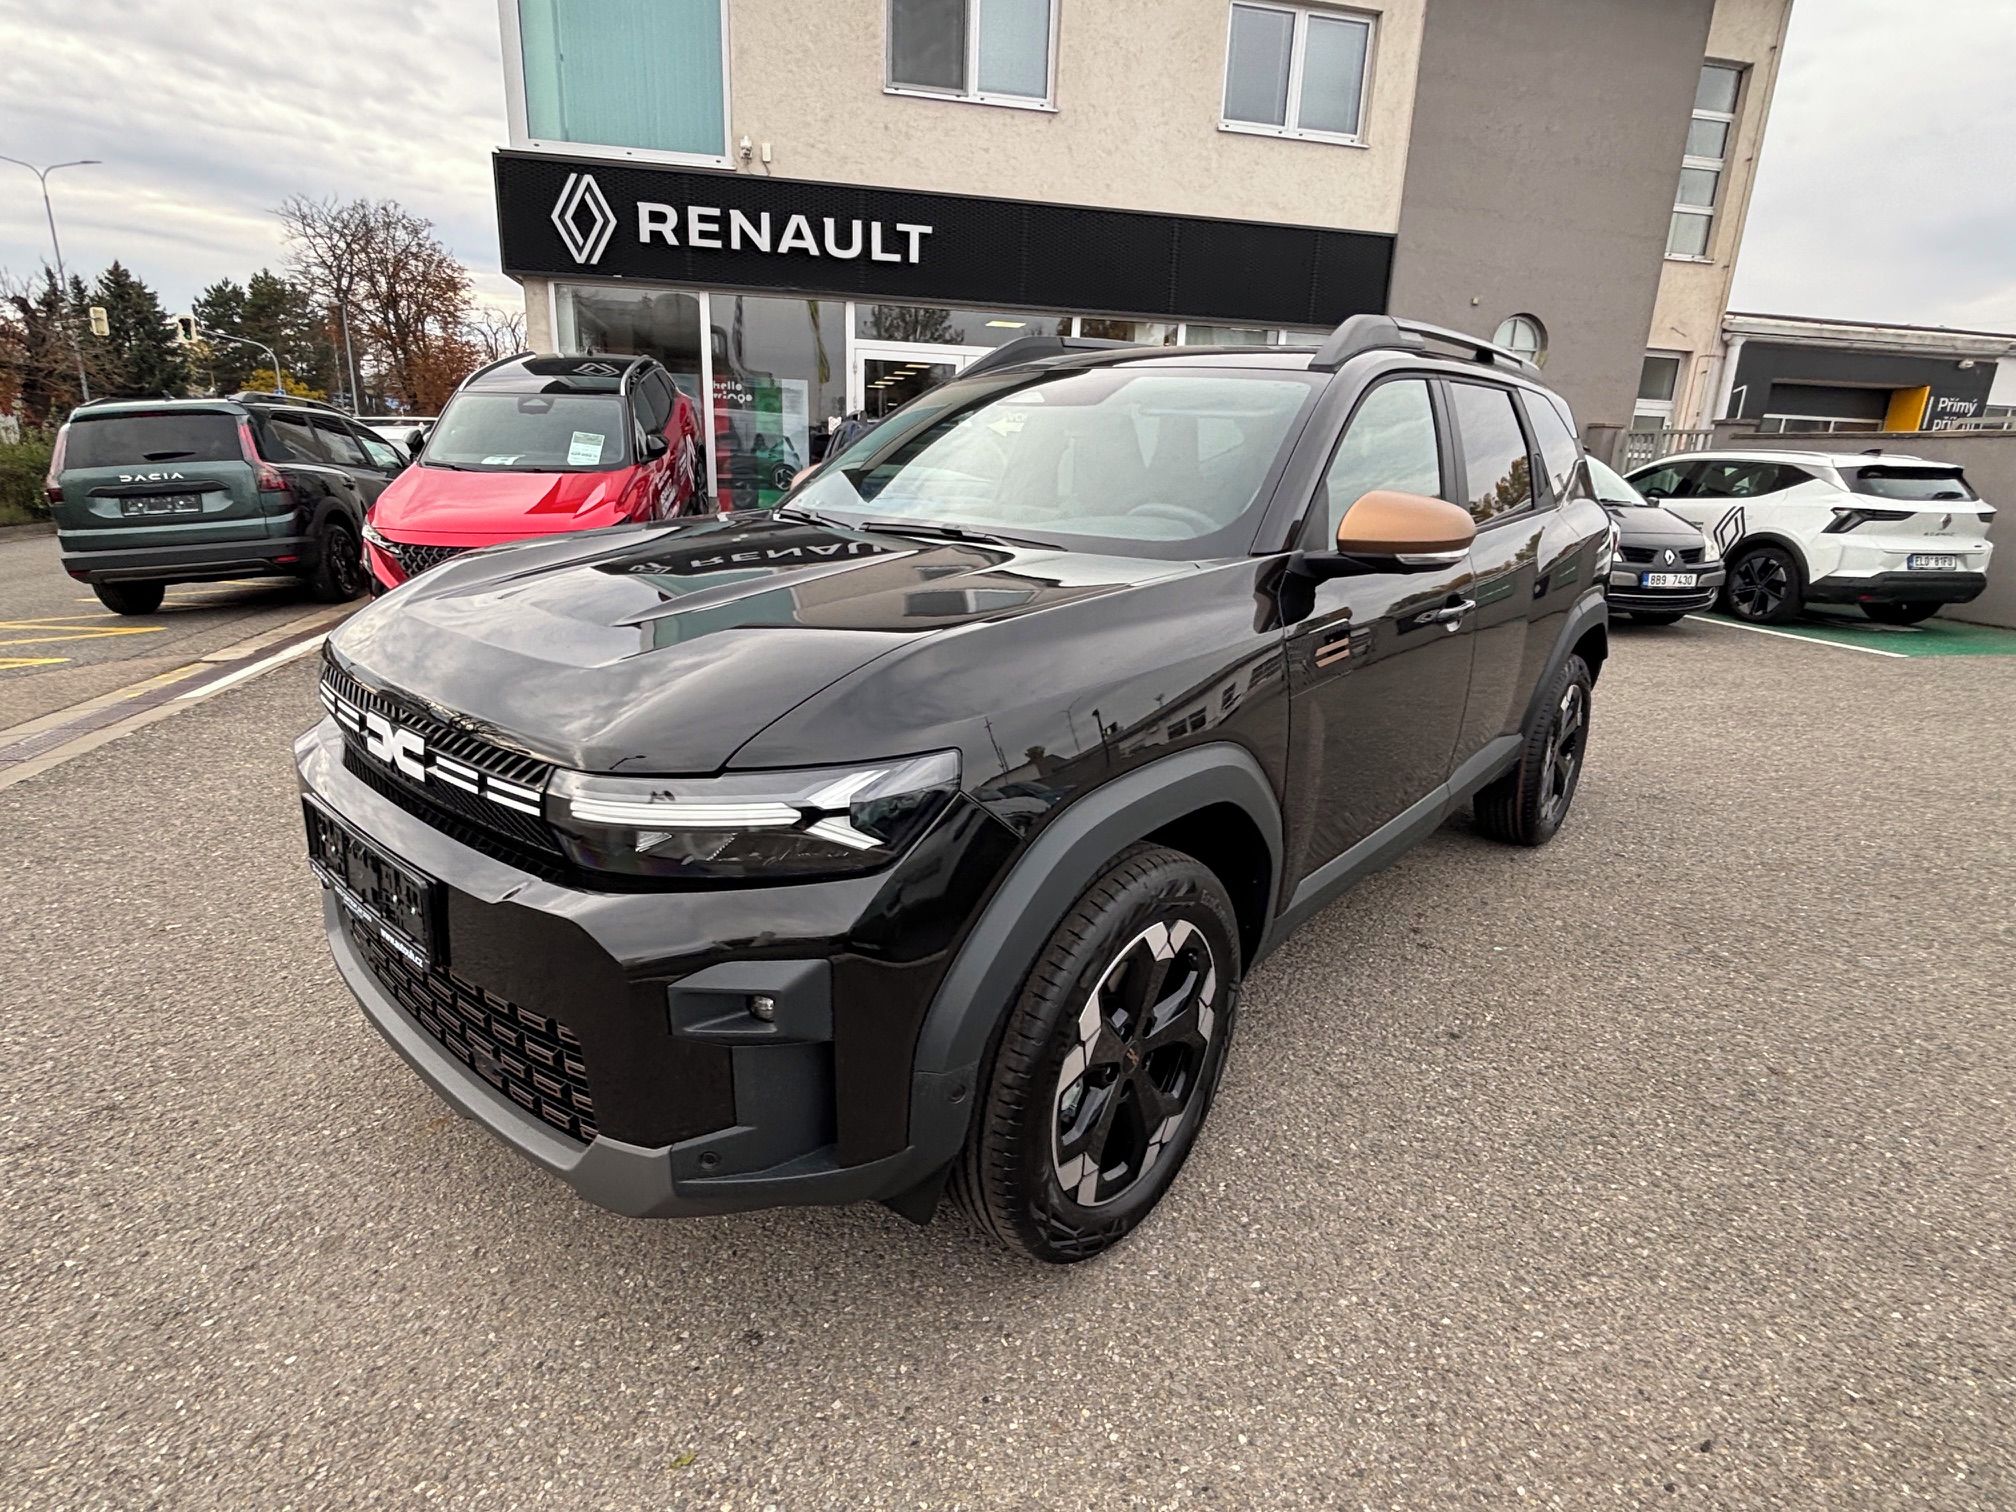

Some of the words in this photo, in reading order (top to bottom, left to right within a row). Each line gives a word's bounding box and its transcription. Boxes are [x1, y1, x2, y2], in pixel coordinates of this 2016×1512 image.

[636, 201, 933, 264] RENAULT
[1937, 397, 1978, 417] Přímý
[119, 472, 184, 482] DACIA
[1672, 574, 1693, 585] 7430
